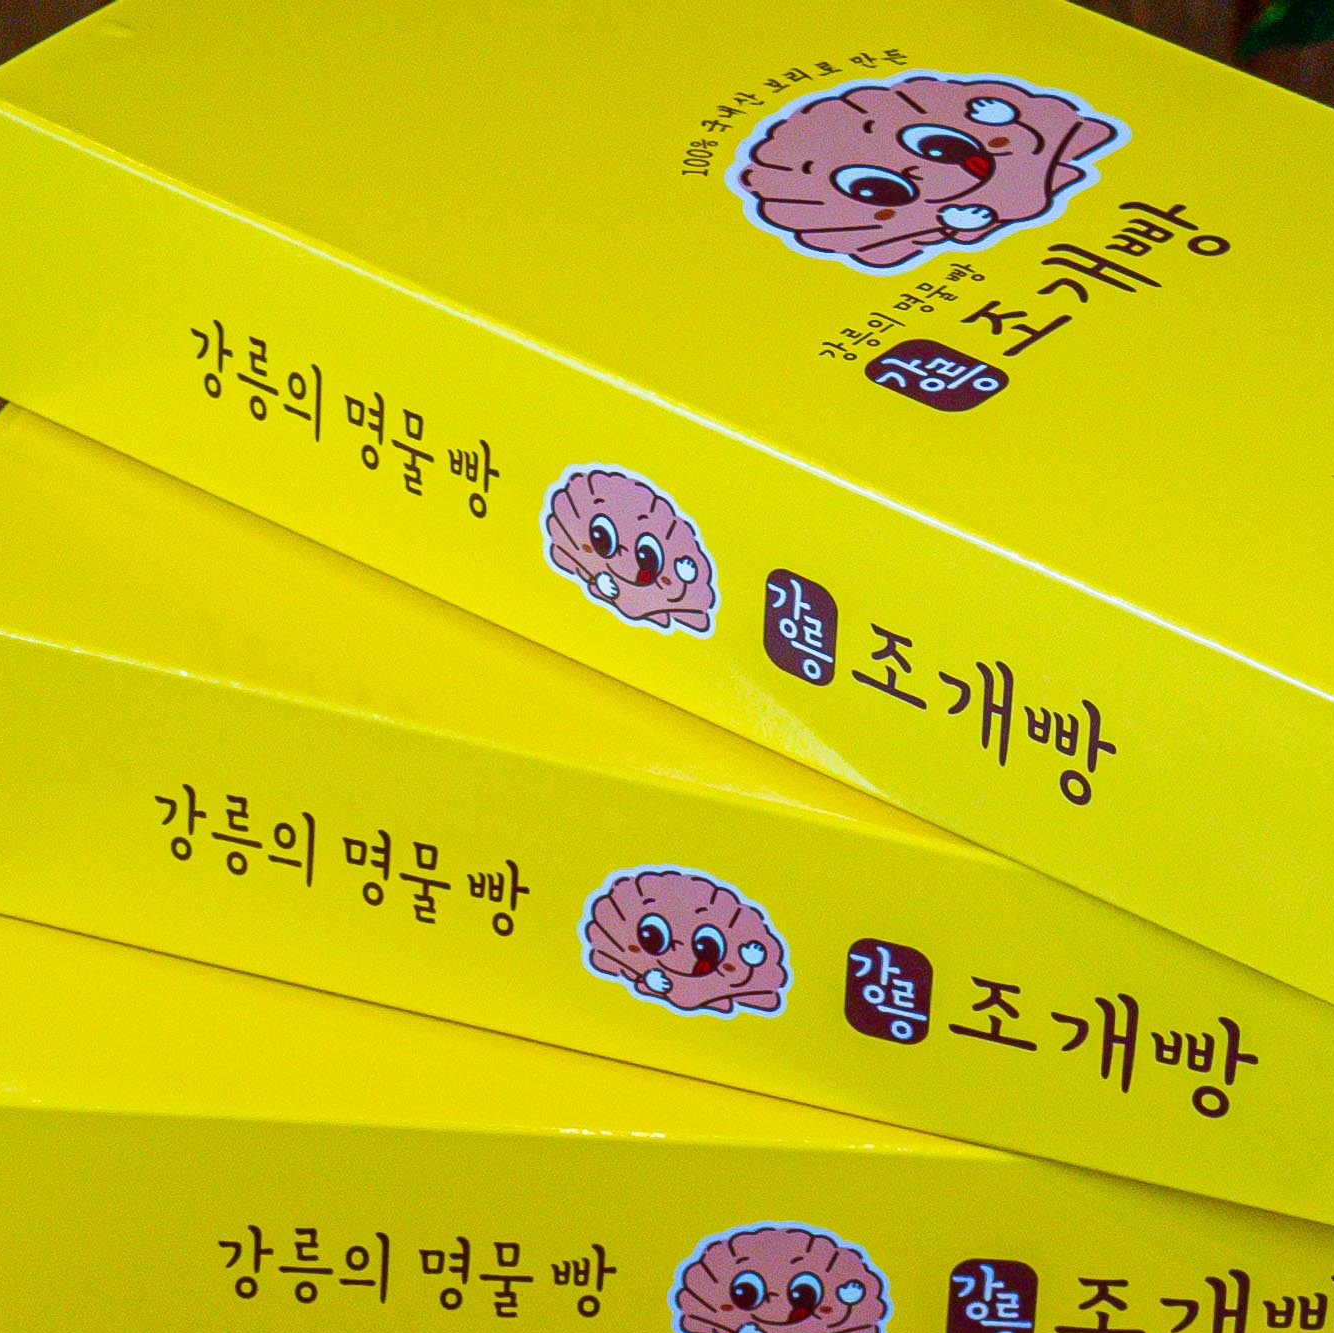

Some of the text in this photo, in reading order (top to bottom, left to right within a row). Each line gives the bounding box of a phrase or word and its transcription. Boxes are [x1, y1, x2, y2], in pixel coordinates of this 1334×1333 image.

[682, 49, 907, 176] 100% 국내산 보리로 만든
[819, 263, 985, 361] 강릉의 명물 빵
[876, 201, 1231, 392] 강릉 조개빵
[191, 320, 1117, 806] 강릉의 명물 빵 강릉 조개빵
[155, 784, 1259, 1118] 강릉의 명물 빵 강릉 조개빵
[218, 1225, 390, 1304] 강릉의
[419, 1236, 534, 1318] 명물
[551, 1243, 617, 1318] 빵
